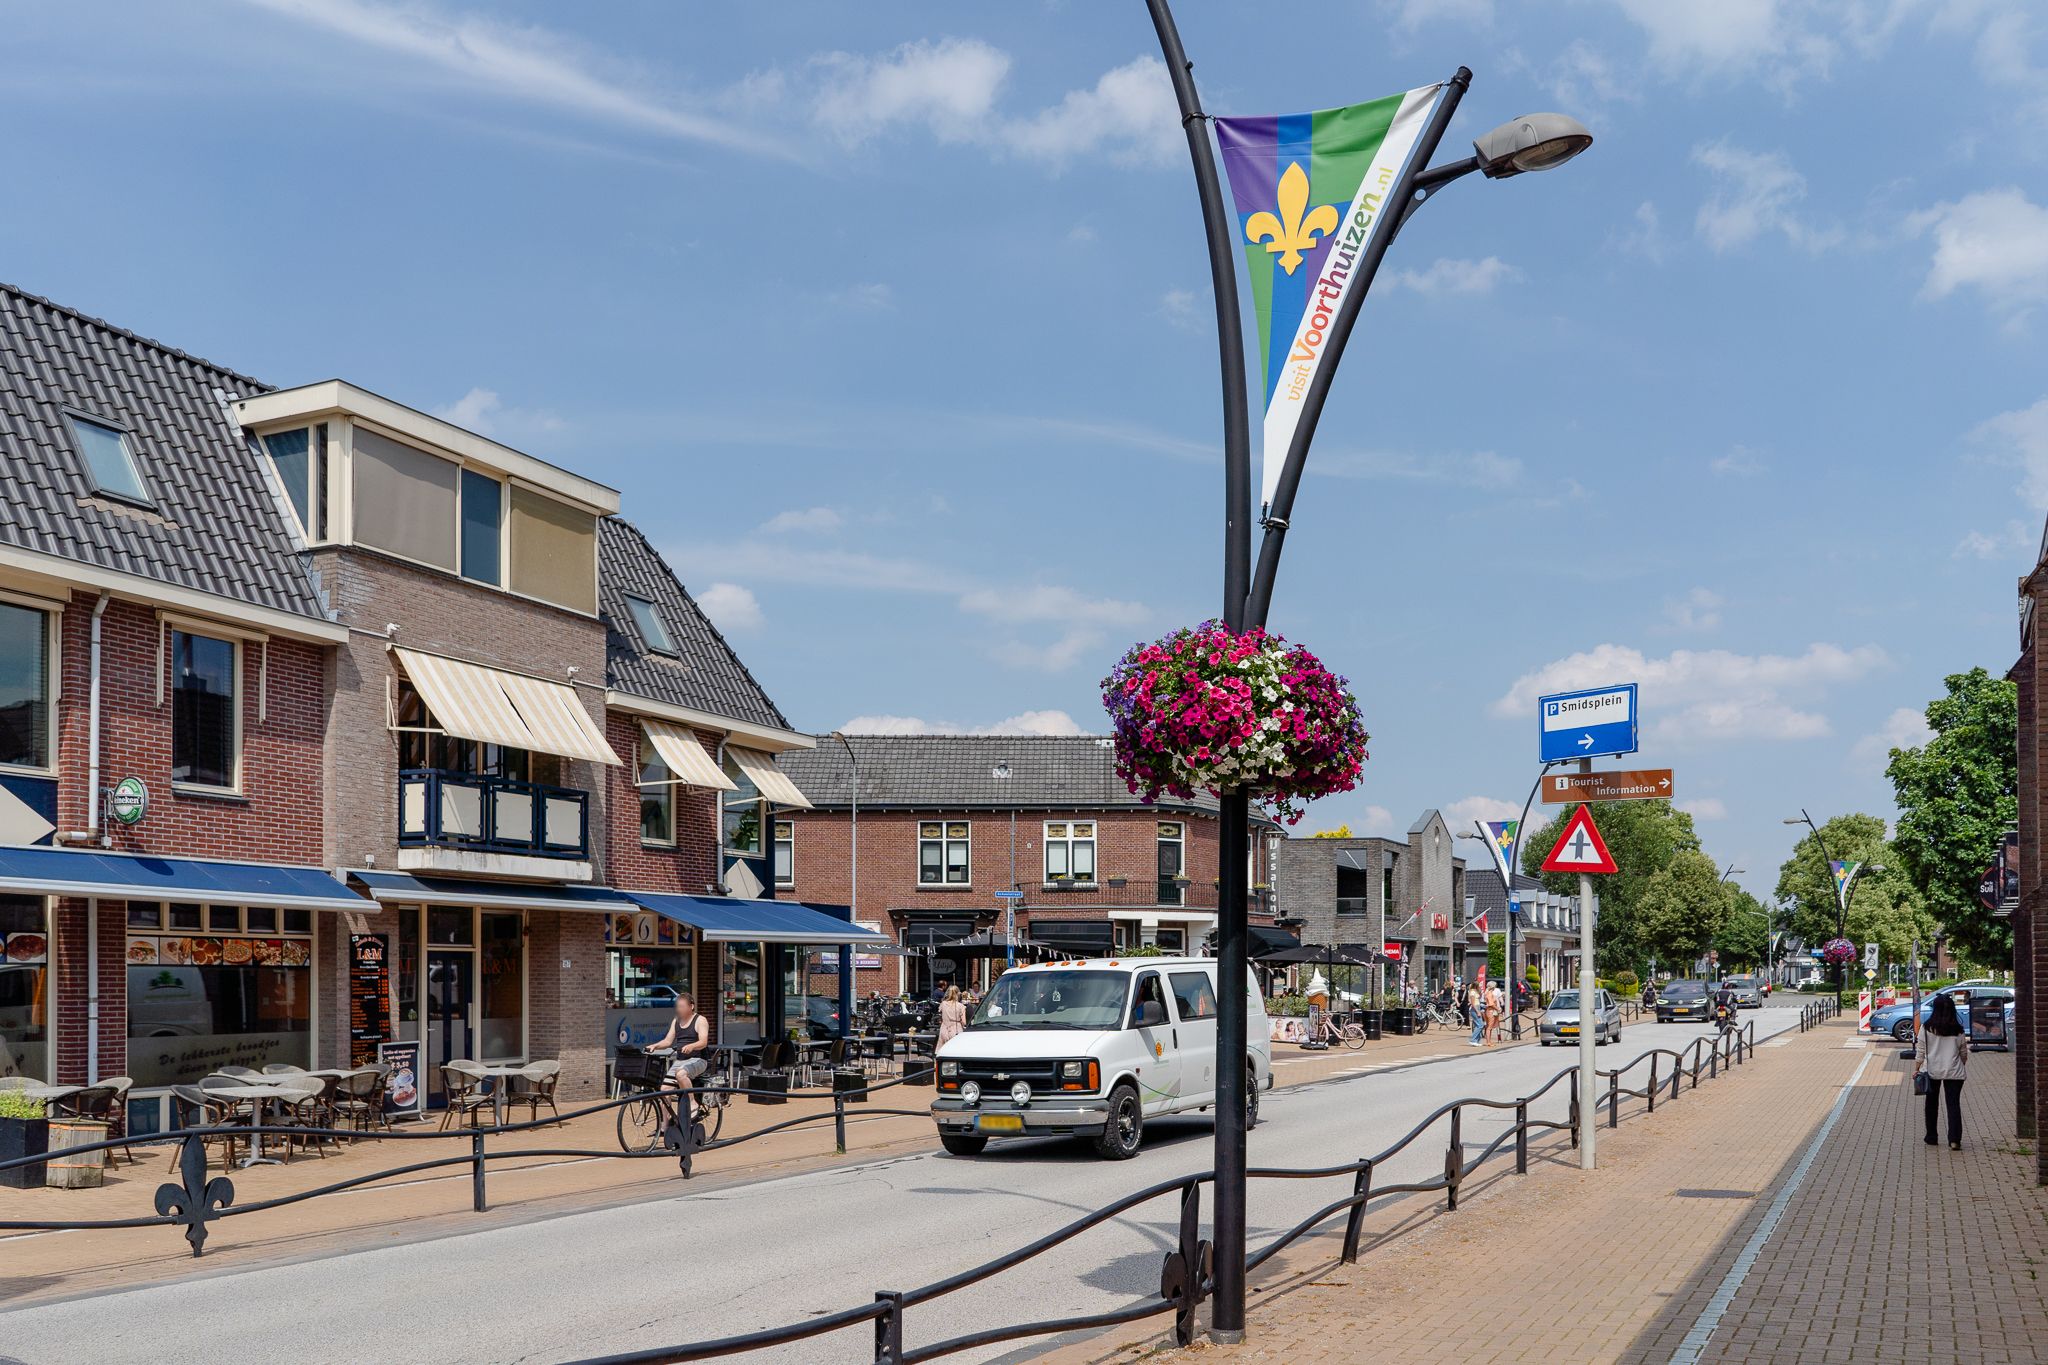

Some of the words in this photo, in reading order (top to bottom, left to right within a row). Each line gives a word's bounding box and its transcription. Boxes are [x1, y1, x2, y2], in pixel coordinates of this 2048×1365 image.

[1561, 695, 1622, 712] Smidsplein
[1570, 777, 1604, 787] Tourist
[1597, 785, 1656, 796] Information
[1431, 912, 1448, 930] HEMA
[357, 948, 382, 960] L&M
[159, 1054, 176, 1066] De
